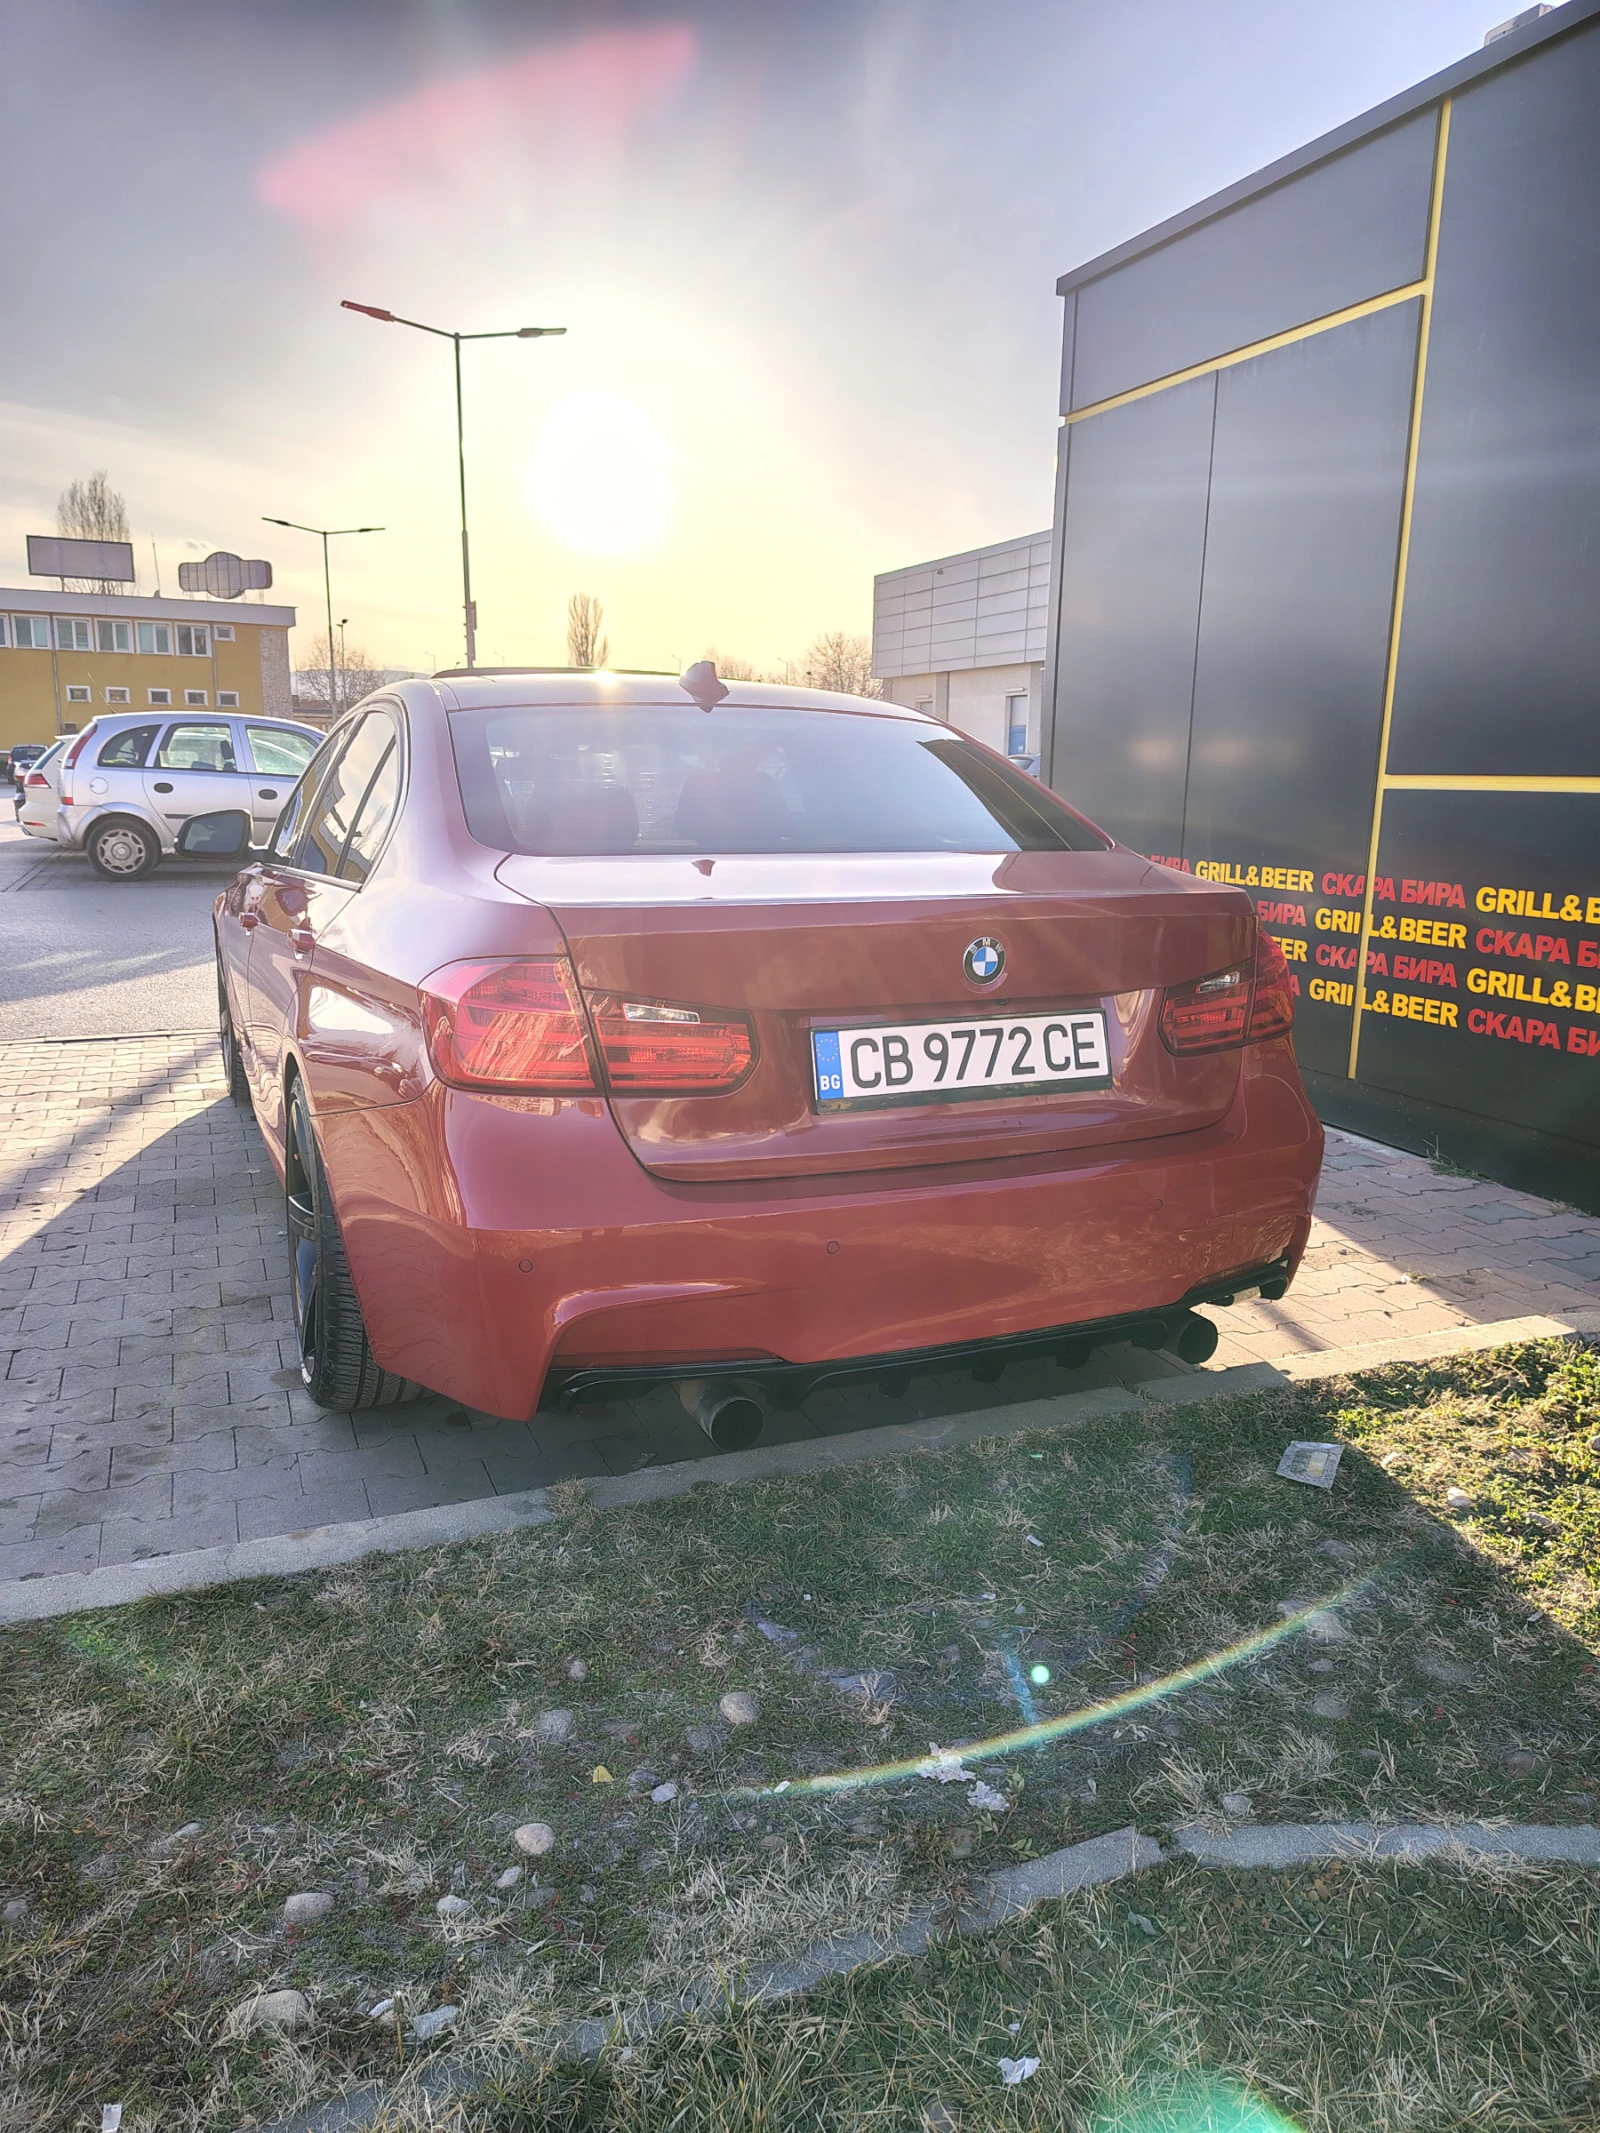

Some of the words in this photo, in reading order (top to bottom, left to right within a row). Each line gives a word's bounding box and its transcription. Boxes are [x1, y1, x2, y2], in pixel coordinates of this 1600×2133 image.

[1195, 861, 1314, 893] GRILL&BEER
[1400, 879, 1466, 909] БИРА
[968, 938, 1004, 954] BMW
[1257, 900, 1307, 927] БИРА
[1475, 928, 1571, 965] СКАРА
[1393, 955, 1458, 988] БИРА
[1466, 968, 1600, 1015] GRILL&B
[1467, 1008, 1561, 1050] СКАРА
[850, 1035, 913, 1089] CB
[923, 1026, 1036, 1083] 9772
[1043, 1021, 1100, 1071] CE
[820, 1074, 841, 1091] BG
